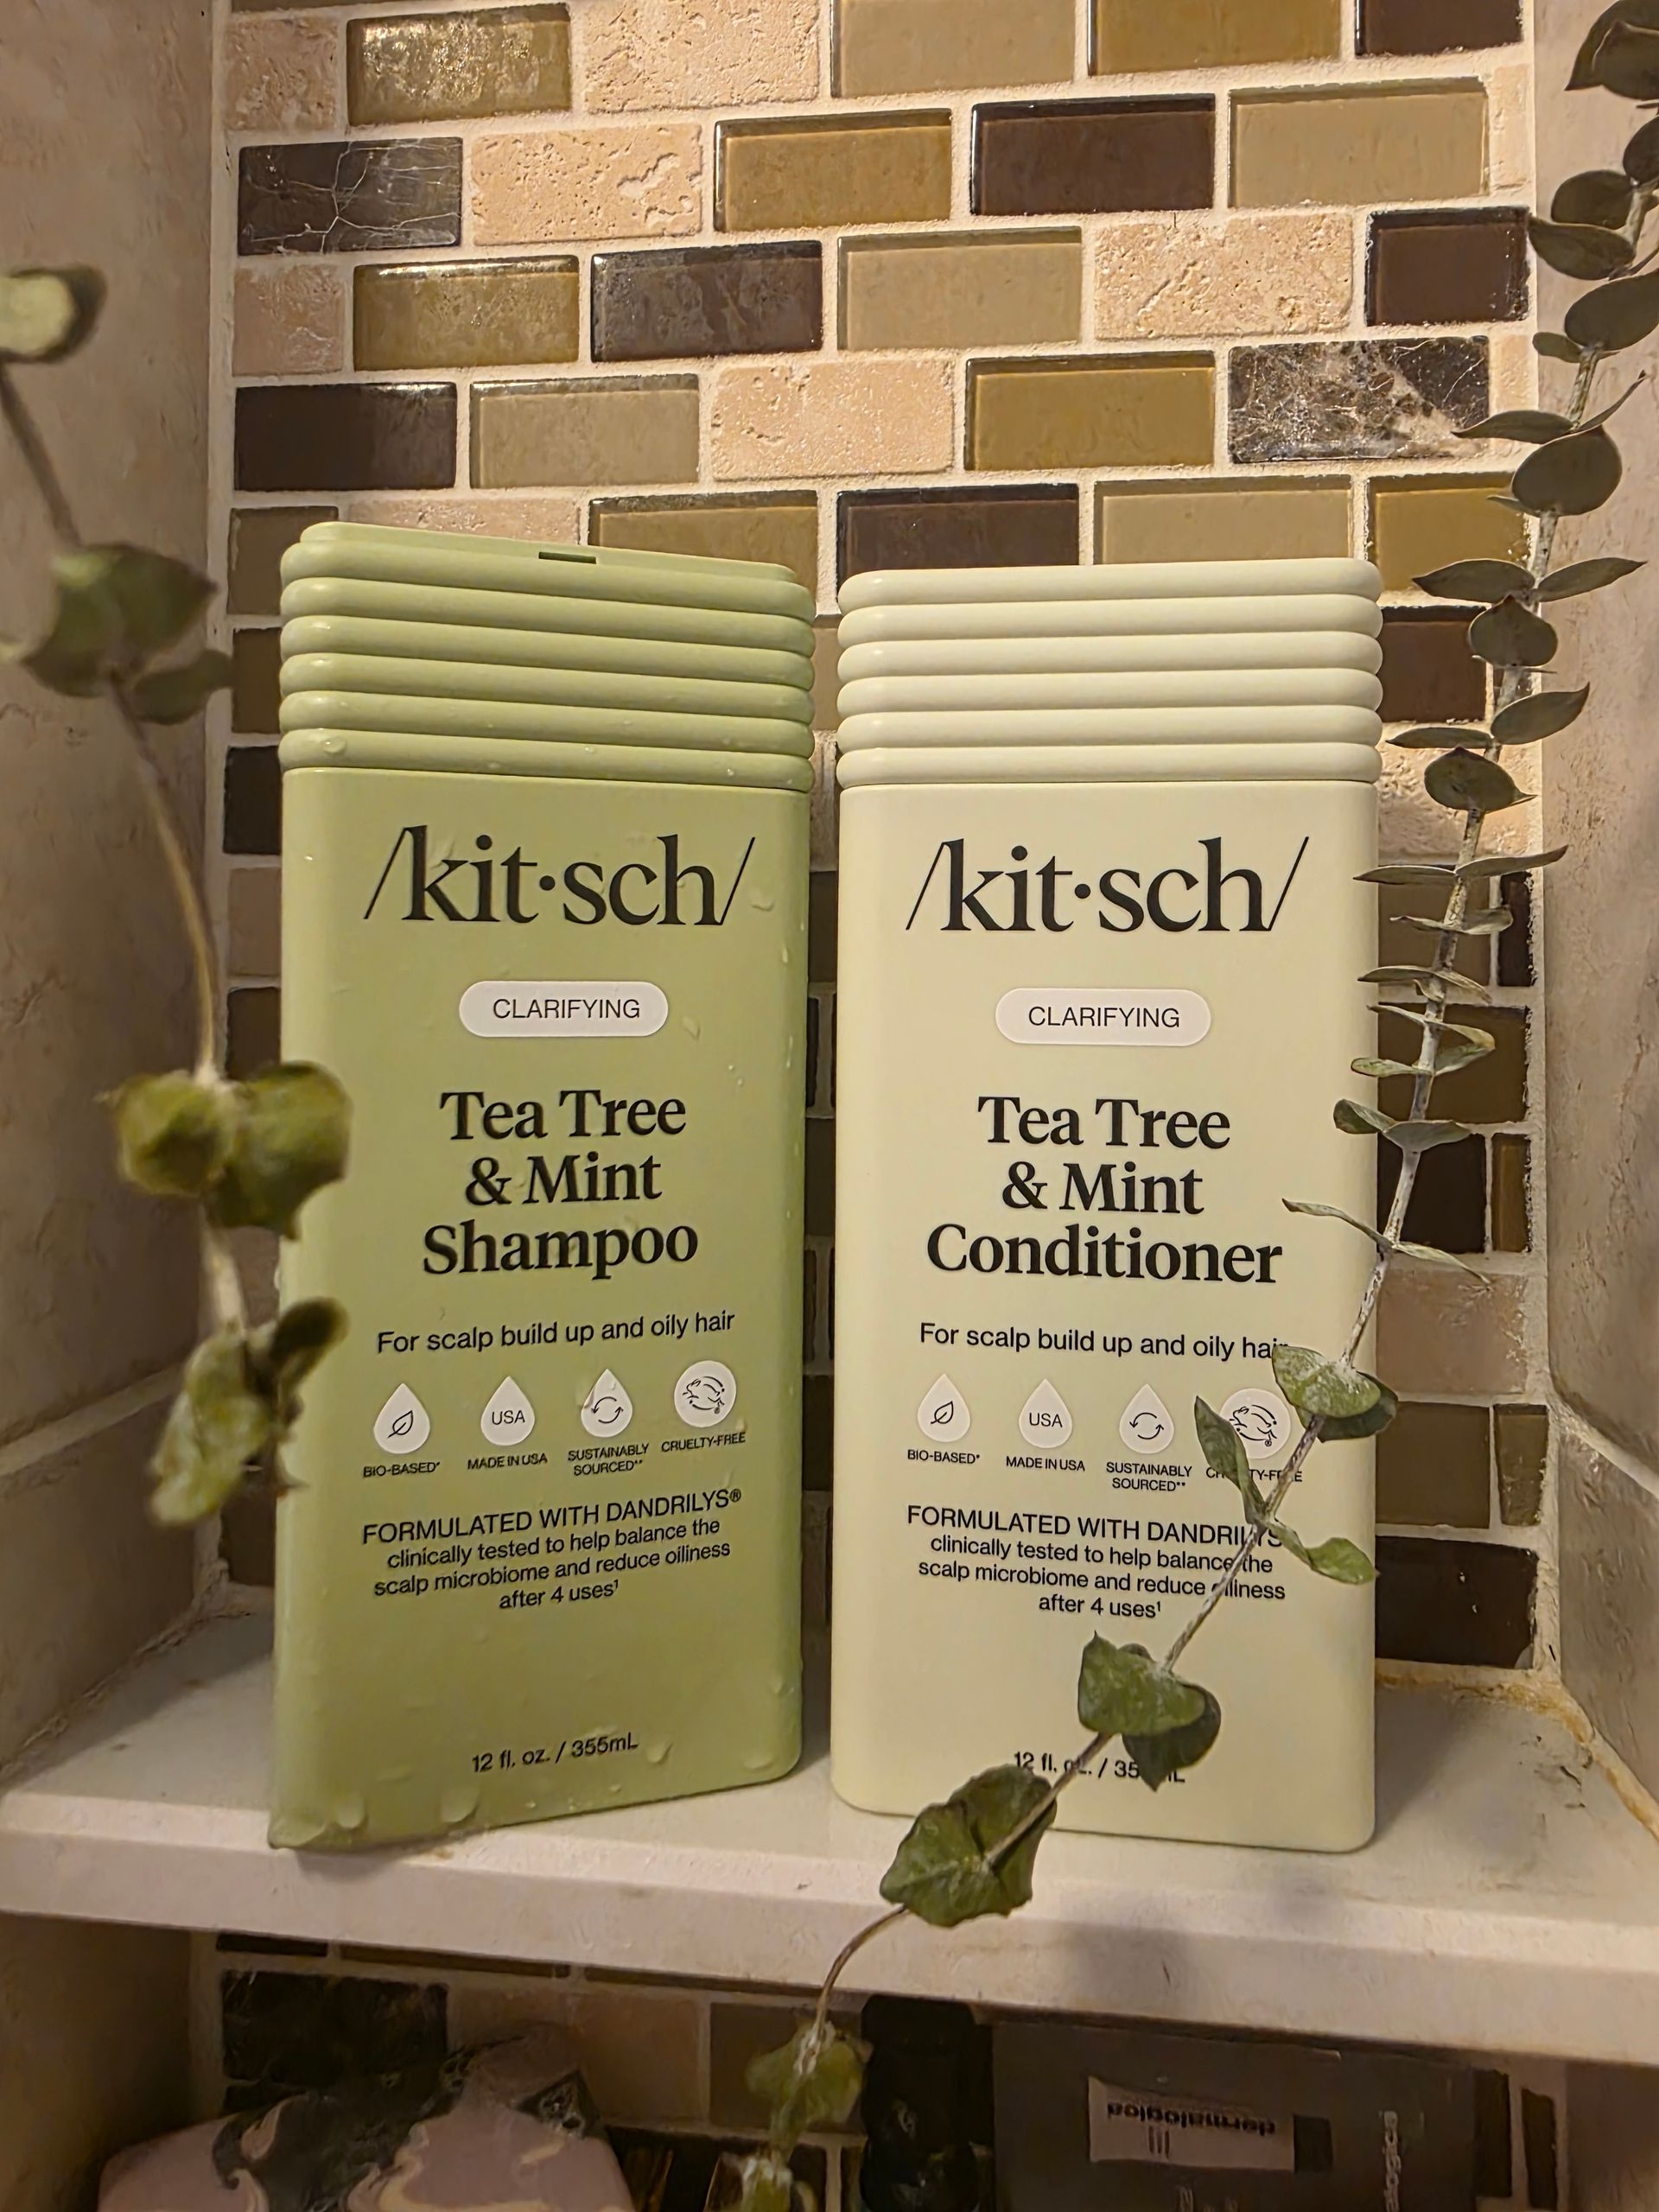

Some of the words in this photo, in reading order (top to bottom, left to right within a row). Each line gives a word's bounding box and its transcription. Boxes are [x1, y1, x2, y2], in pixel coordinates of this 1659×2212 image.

[493, 999, 639, 1019] CLARIFYING
[1029, 1007, 1179, 1027] CLARIFYING
[439, 1091, 549, 1141] Tea
[559, 1090, 686, 1137] Tree
[977, 1096, 1084, 1146] Tea
[1095, 1098, 1230, 1149] Tree
[465, 1157, 512, 1206] &
[520, 1151, 662, 1205] Mint
[1002, 1161, 1048, 1210] &
[1059, 1161, 1205, 1215] Mint
[423, 1219, 698, 1281] Shampoo
[927, 1224, 1282, 1283] Conditioner
[378, 1332, 420, 1354] For
[427, 1326, 493, 1352] scalp
[501, 1321, 557, 1346] build
[566, 1325, 594, 1346] up
[601, 1316, 644, 1340] and
[651, 1314, 689, 1340] oily
[696, 1310, 735, 1333] hair
[921, 1322, 959, 1344] For
[967, 1326, 1030, 1352] scalp
[1039, 1328, 1094, 1351] build
[1103, 1336, 1132, 1357] up
[1141, 1334, 1185, 1356] and
[1193, 1336, 1235, 1362] oily
[1243, 1337, 1288, 1358] ha
[492, 1410, 524, 1425] USA
[1029, 1413, 1063, 1427] USA
[568, 1443, 649, 1462] SUSTAINABLY
[661, 1430, 746, 1452] CRUELTY-FREE
[467, 1456, 505, 1470] MADE
[507, 1456, 519, 1466] IN
[522, 1453, 548, 1465] USA
[1006, 1456, 1043, 1469] MADE
[1046, 1459, 1057, 1470] IN
[1059, 1459, 1085, 1471] USA
[1106, 1462, 1192, 1477] SUSTAINABLY
[362, 1510, 532, 1544] FORMULATED
[539, 1504, 599, 1529] WITH
[606, 1488, 741, 1522] DANDRILYS®
[908, 1505, 1071, 1535] FORMULATED
[1077, 1516, 1139, 1540] WITH
[387, 1538, 472, 1569] clinically
[478, 1537, 539, 1560] tested
[546, 1537, 564, 1554] to
[569, 1528, 610, 1556] help
[615, 1522, 687, 1549] balance
[692, 1518, 720, 1535] the
[931, 1535, 1011, 1560] clinically
[1017, 1541, 1077, 1561] tested
[1084, 1545, 1103, 1563] to
[1110, 1547, 1151, 1570] help
[1156, 1550, 1234, 1572] balance
[1243, 1555, 1273, 1573] the
[374, 1575, 429, 1596] scalp
[434, 1561, 550, 1591] microbiome
[555, 1557, 590, 1578] and
[596, 1553, 659, 1573] reduce
[665, 1543, 730, 1564] oiliness
[918, 1560, 969, 1582] scalp
[976, 1564, 1089, 1588] microbiome
[1094, 1569, 1130, 1591] and
[1137, 1575, 1205, 1595] reduce
[499, 1586, 545, 1609] after
[550, 1586, 564, 1604] 4
[1039, 1593, 1085, 1613] after
[1090, 1598, 1103, 1616] 4
[473, 1753, 493, 1772] 12
[499, 1750, 515, 1769] fl.
[522, 1750, 550, 1765] oz.
[556, 1741, 566, 1764] /
[571, 1732, 639, 1758] 355mL
[1014, 1751, 1034, 1769] 12
[1042, 1752, 1057, 1772] fl.
[1098, 1758, 1108, 1779] /
